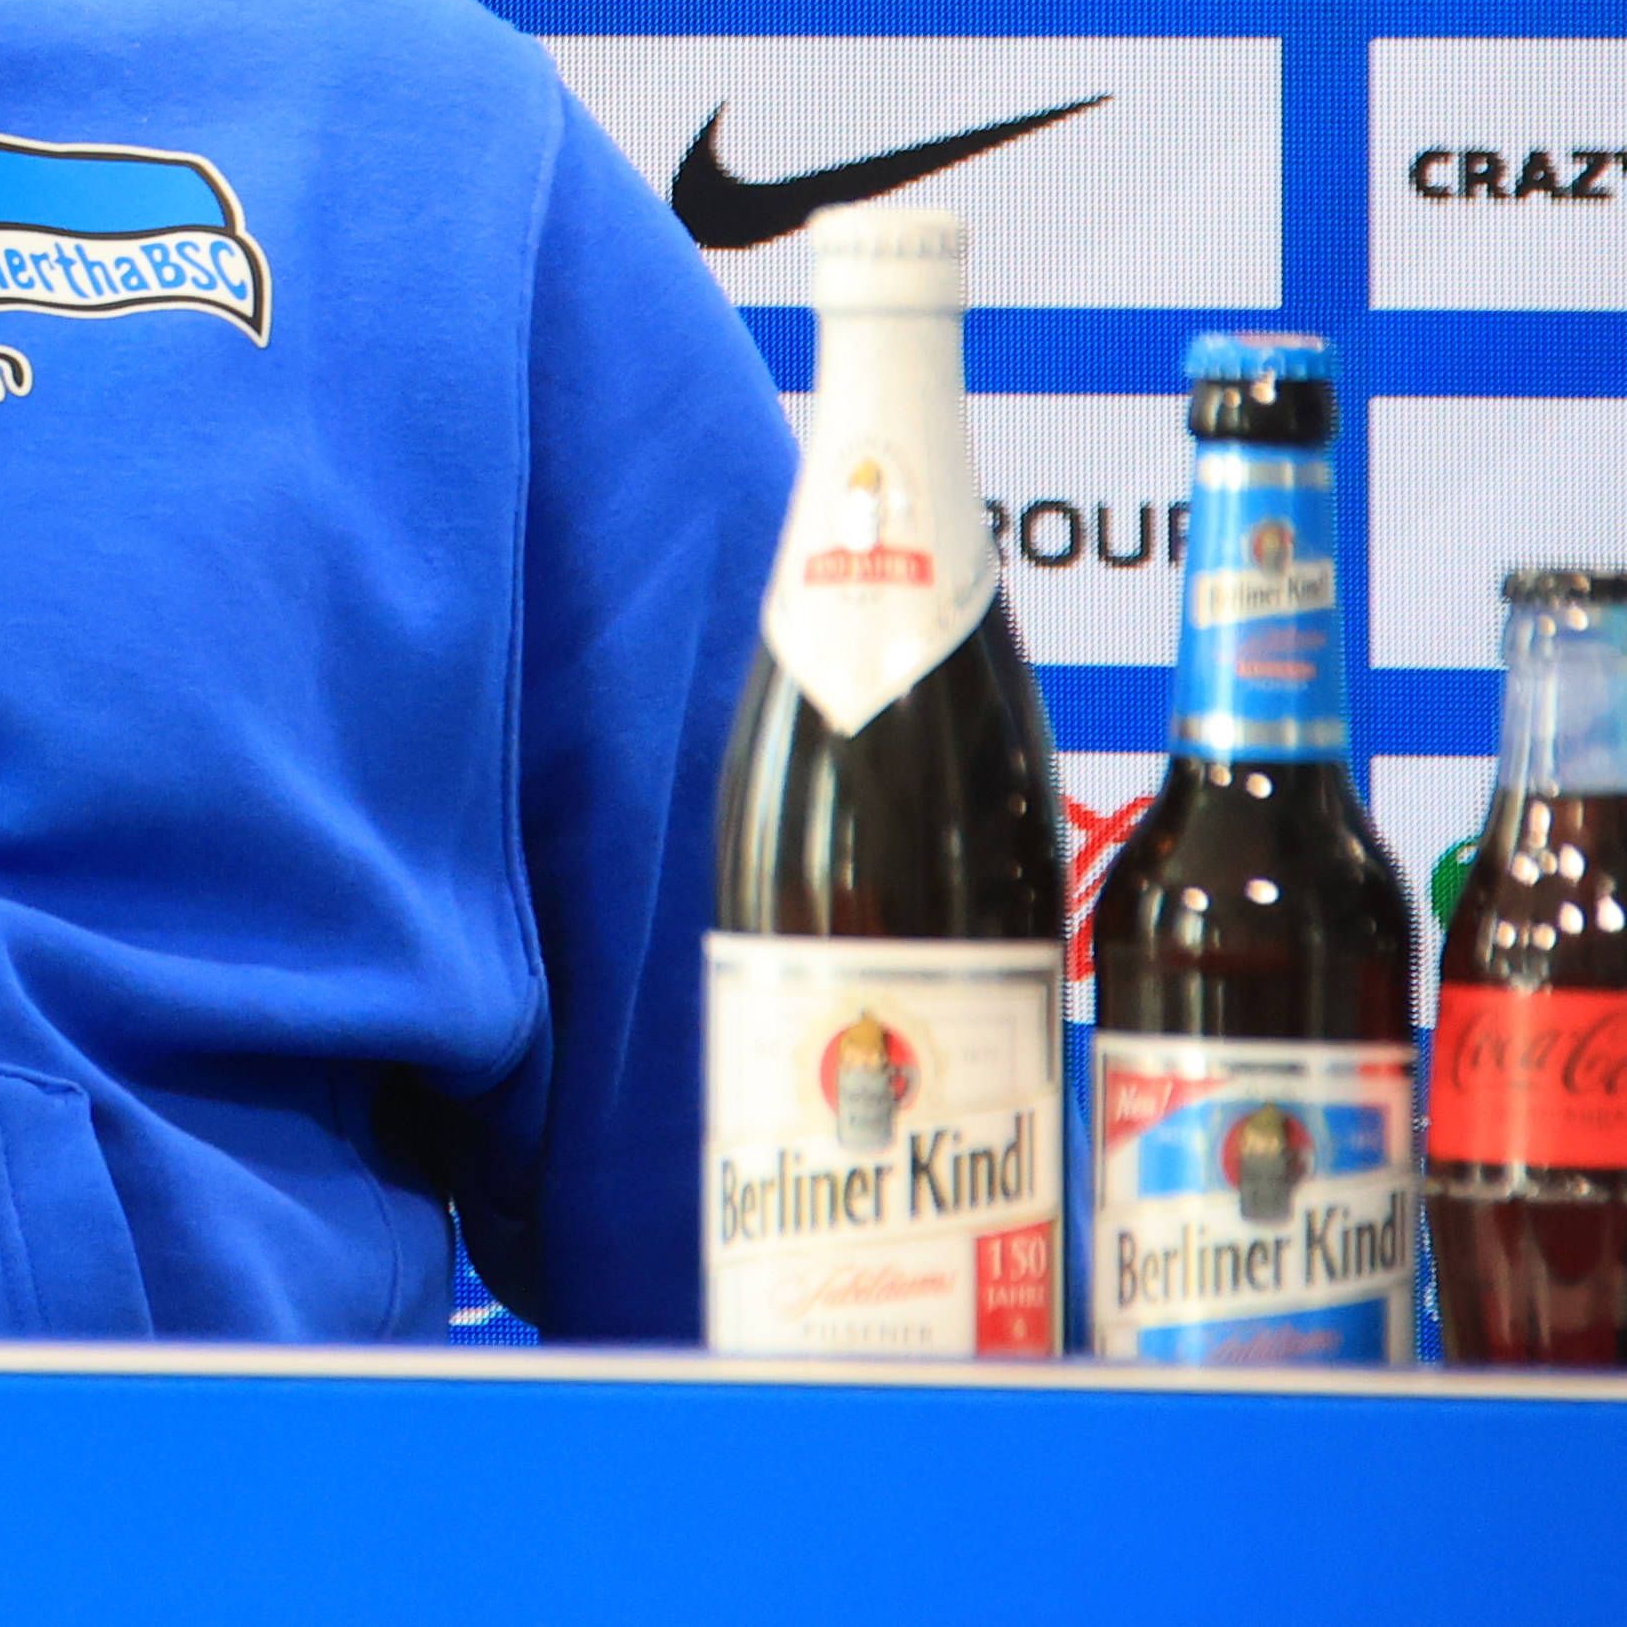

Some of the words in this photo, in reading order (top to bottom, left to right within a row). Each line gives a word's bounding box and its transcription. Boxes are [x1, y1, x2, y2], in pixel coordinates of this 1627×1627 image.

[1409, 150, 1627, 200] CRAZ
[719, 1148, 893, 1246] Berliner
[908, 1110, 1036, 1219] Kindl
[1116, 1225, 1291, 1308] Berliner
[1304, 1190, 1406, 1288] Kindl
